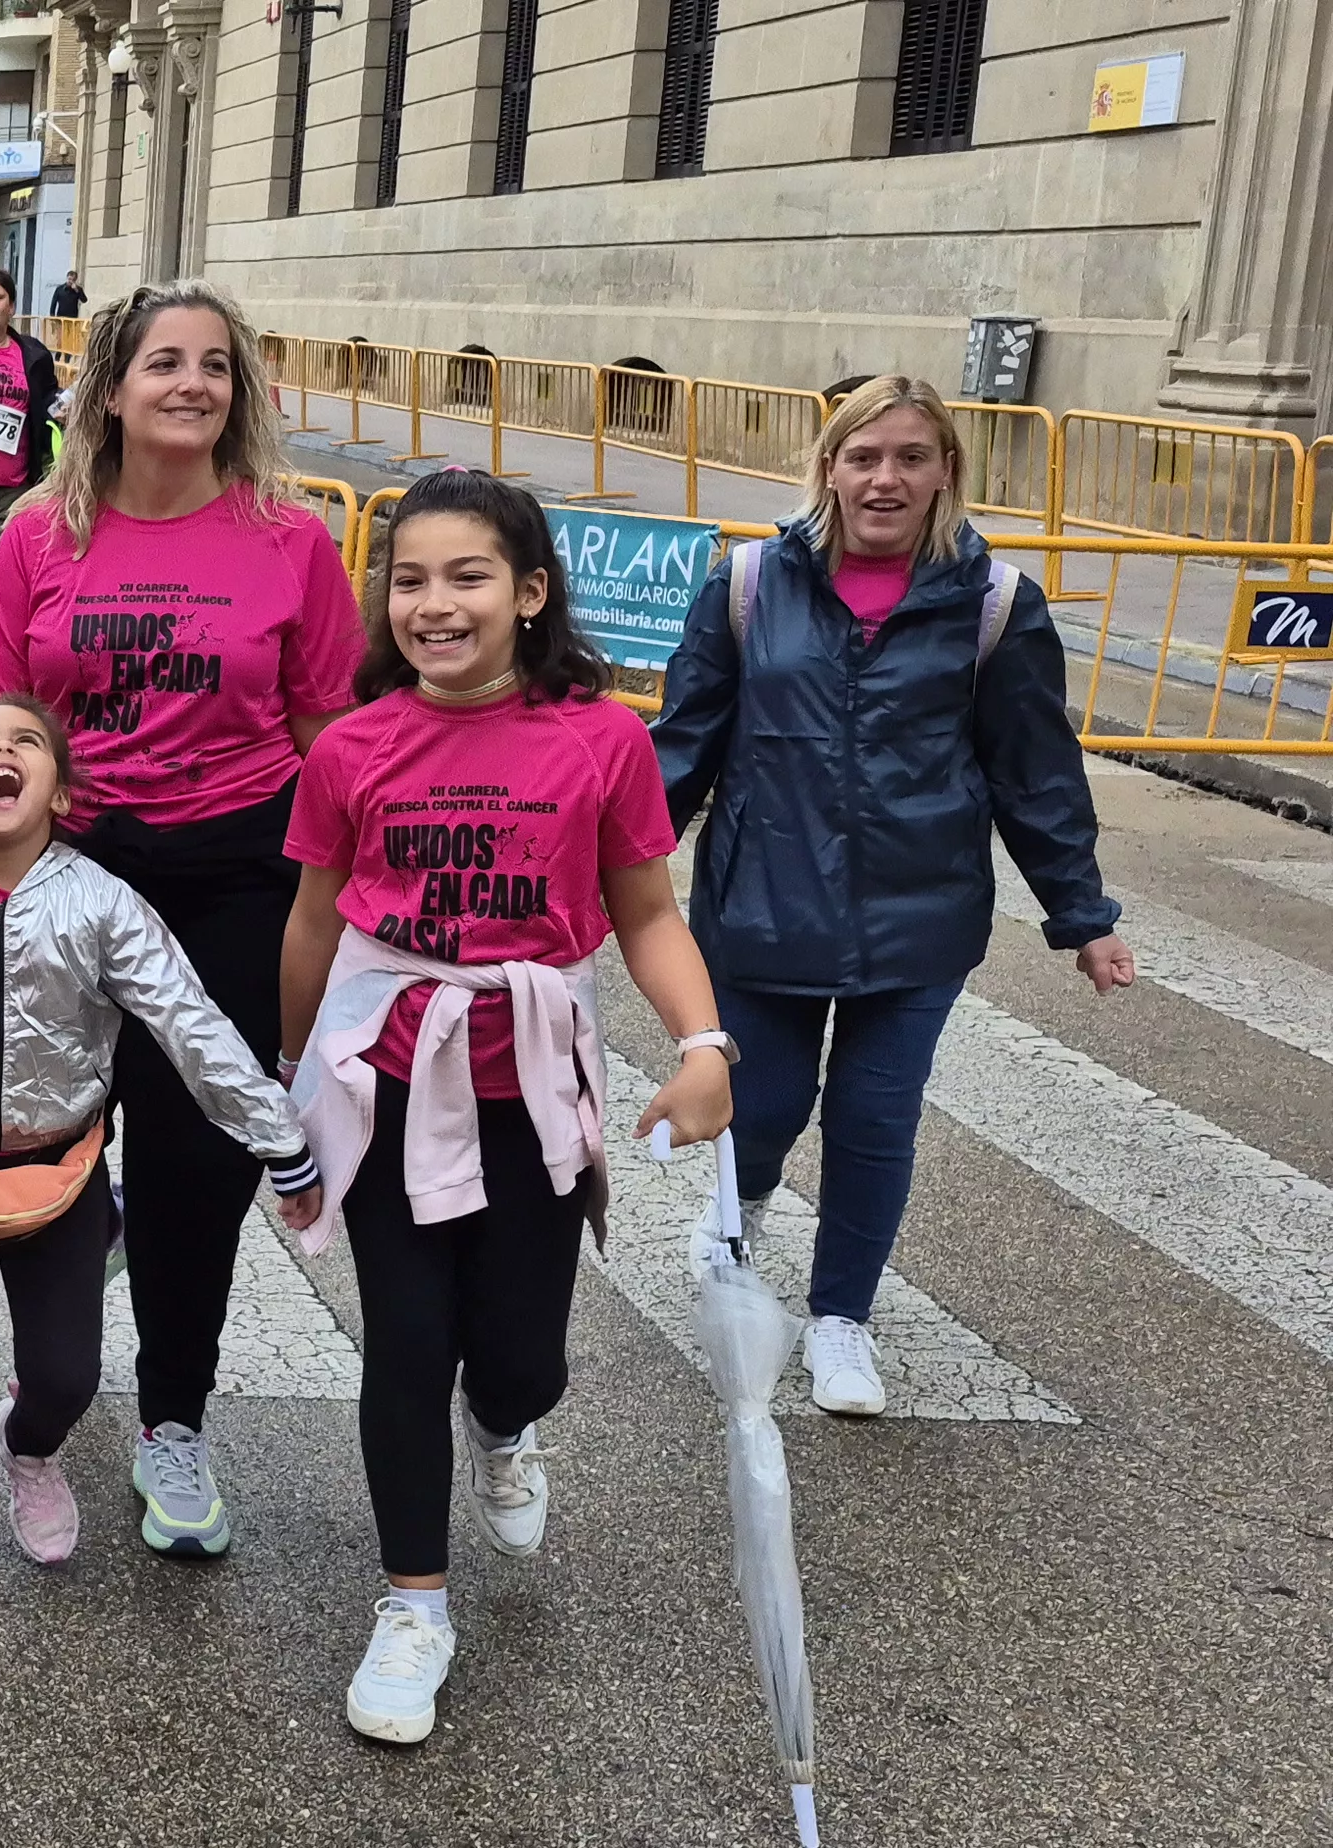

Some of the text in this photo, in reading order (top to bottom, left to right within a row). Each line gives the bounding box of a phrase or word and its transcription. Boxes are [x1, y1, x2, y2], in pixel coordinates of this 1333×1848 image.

[75, 593, 233, 607] HUESCA CONTRA EL CÁNCER
[135, 583, 190, 593] CARRERA
[576, 577, 691, 608] INMOBILIARIOS
[70, 612, 177, 653] UNIDOS
[110, 652, 222, 696] EN CADA
[67, 691, 143, 735] PASO
[383, 800, 558, 815] HUESCA CONTRA EL CÁNCER
[429, 785, 509, 797] XII CARRERA
[383, 822, 496, 871] UNIDOS
[421, 871, 547, 921] EN CADA
[373, 913, 460, 965] PASO
